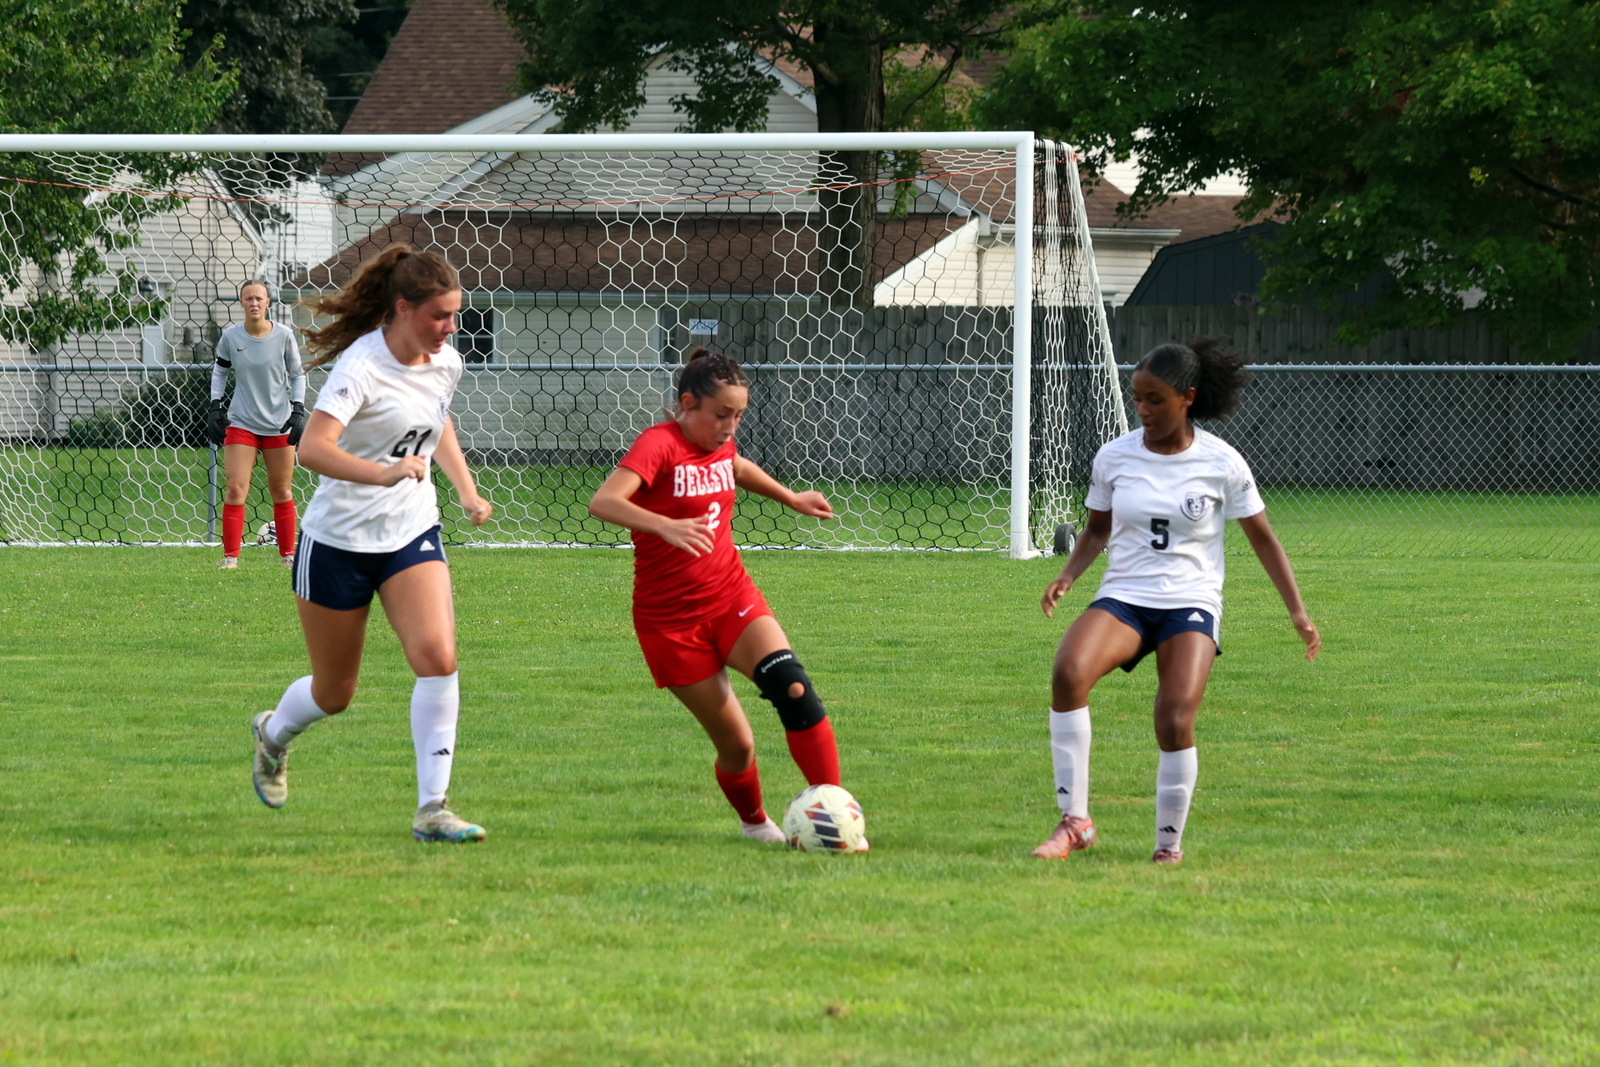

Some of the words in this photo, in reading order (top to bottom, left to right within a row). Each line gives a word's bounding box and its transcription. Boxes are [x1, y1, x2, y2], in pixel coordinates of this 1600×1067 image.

[391, 428, 432, 458] 21
[707, 501, 721, 530] 2
[1150, 517, 1170, 550] 5
